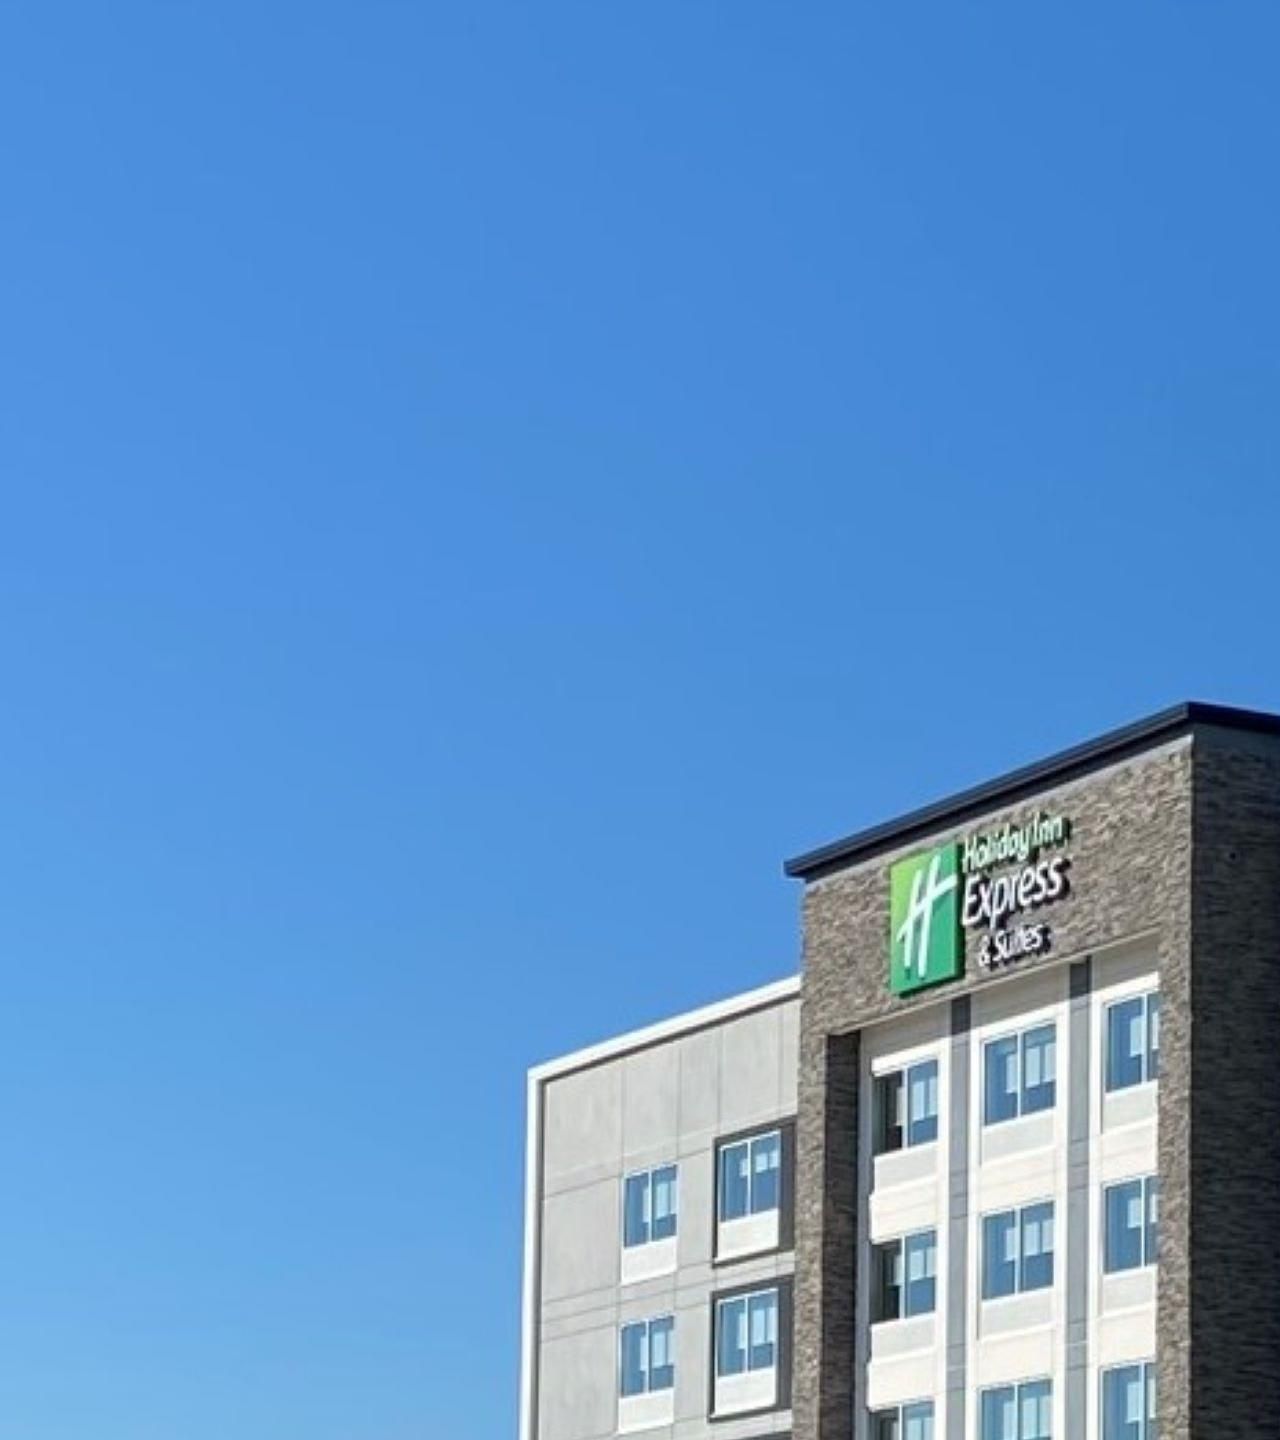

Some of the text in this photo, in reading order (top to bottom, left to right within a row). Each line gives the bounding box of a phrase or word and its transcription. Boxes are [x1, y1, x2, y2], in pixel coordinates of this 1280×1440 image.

[962, 811, 1064, 872] Holiday Inn
[896, 854, 957, 977] H
[961, 857, 1064, 930] Express
[978, 923, 1045, 967] & Suites
